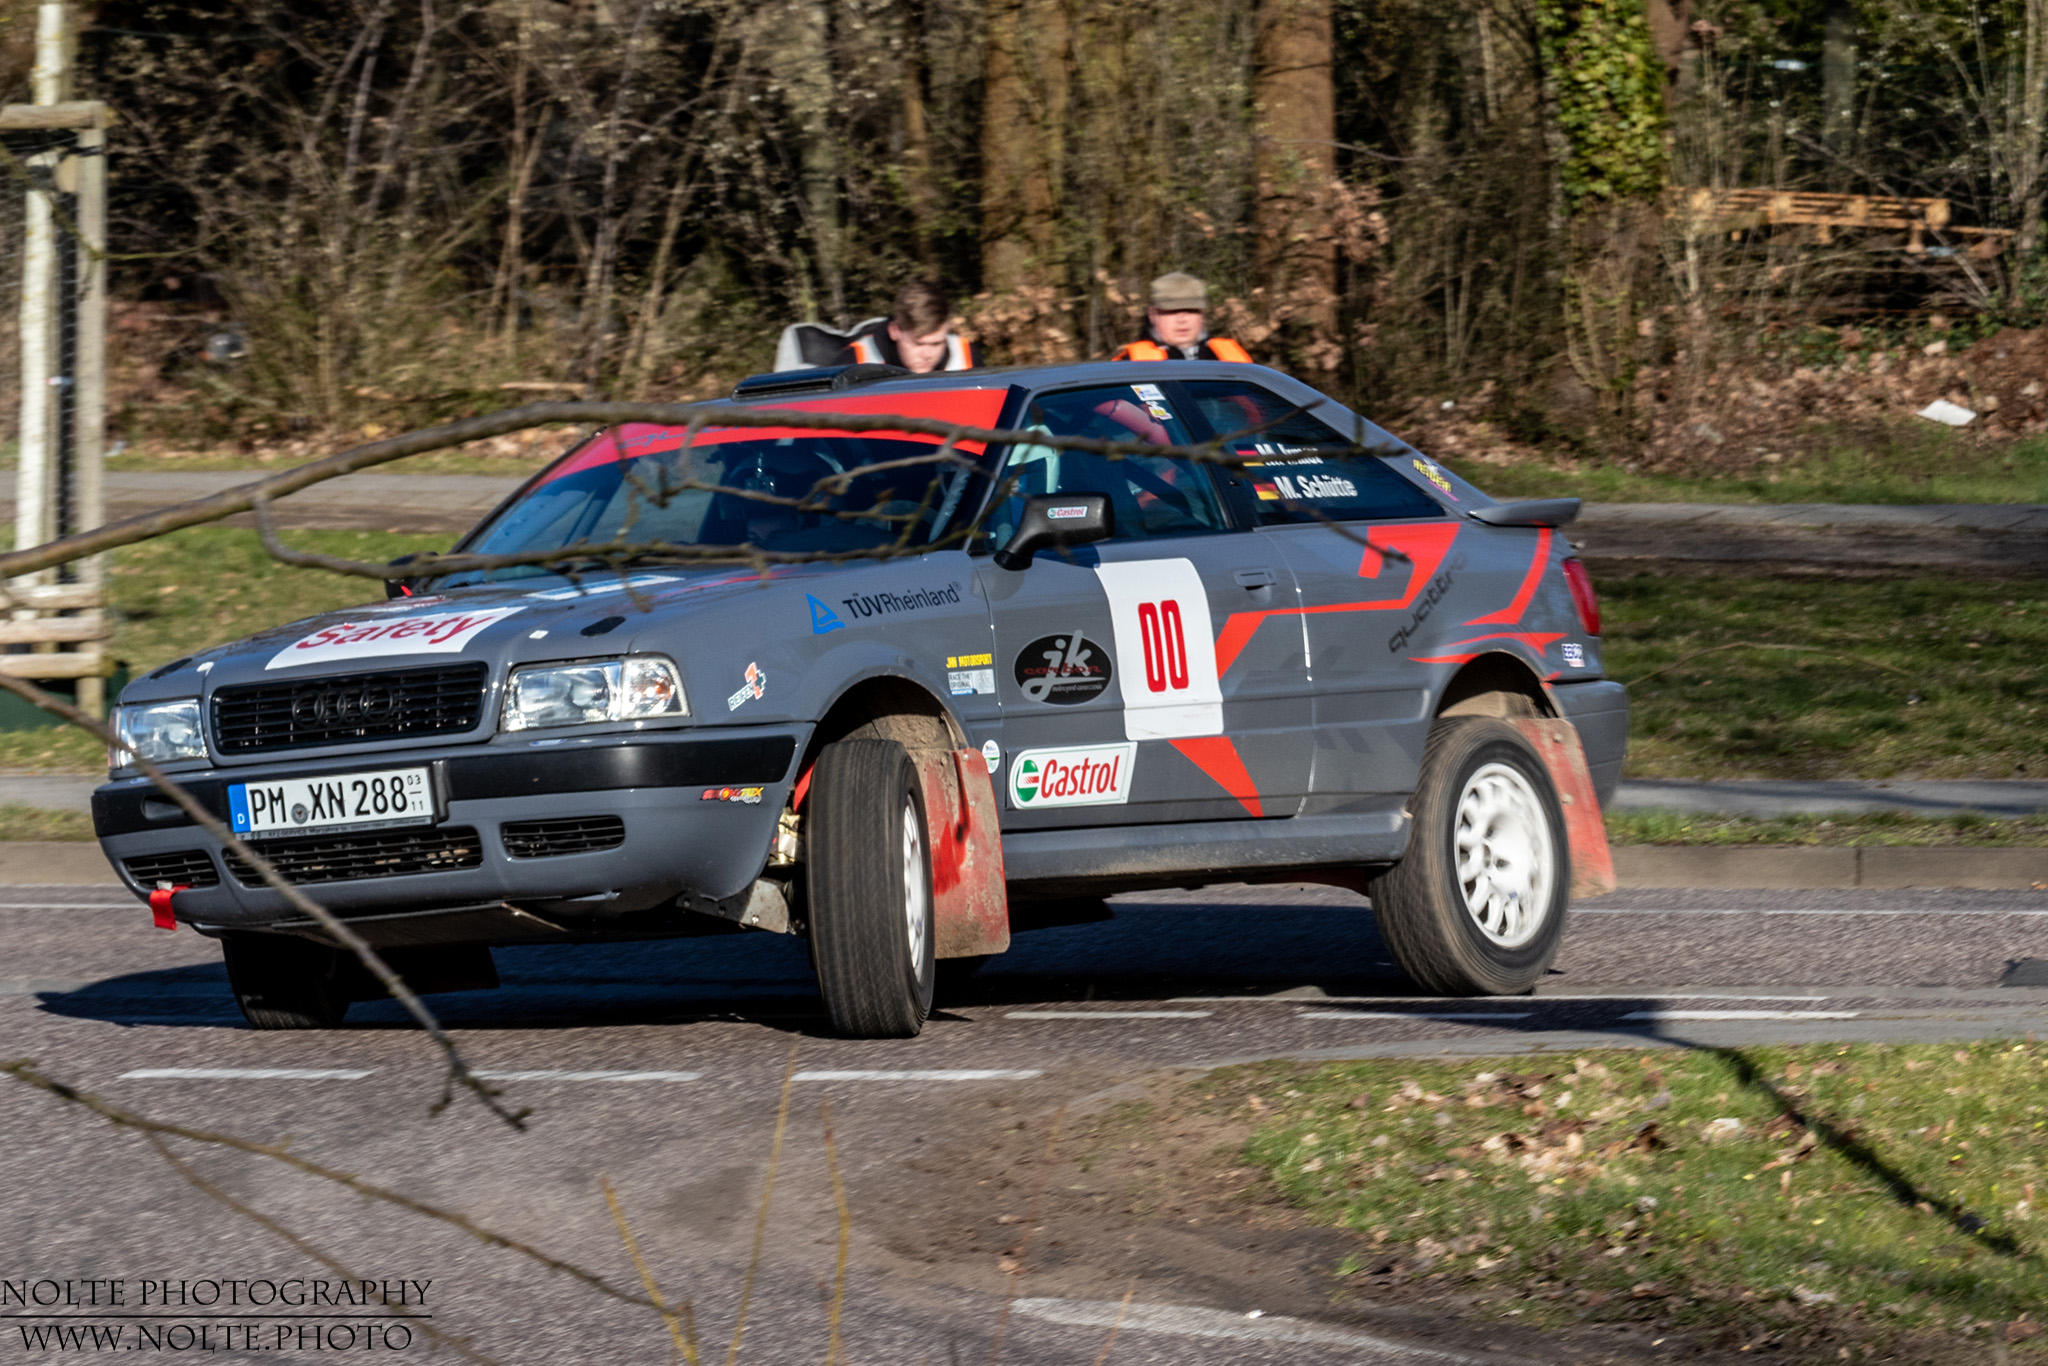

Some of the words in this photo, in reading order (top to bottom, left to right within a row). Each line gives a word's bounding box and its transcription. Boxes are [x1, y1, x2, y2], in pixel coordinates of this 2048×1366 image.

[1274, 476, 1302, 499] M.
[1297, 474, 1358, 498] Schütte
[1056, 507, 1085, 517] Castrol
[1388, 553, 1468, 654] quattro
[296, 614, 496, 650] Safety
[1138, 599, 1189, 693] 00
[1024, 662, 1102, 676] carbon
[407, 774, 422, 787] 03
[1040, 754, 1120, 800] Castrol
[250, 787, 287, 825] PM
[309, 781, 346, 821] XN
[353, 776, 407, 817] 288
[411, 800, 424, 812] 11
[237, 813, 246, 825] D
